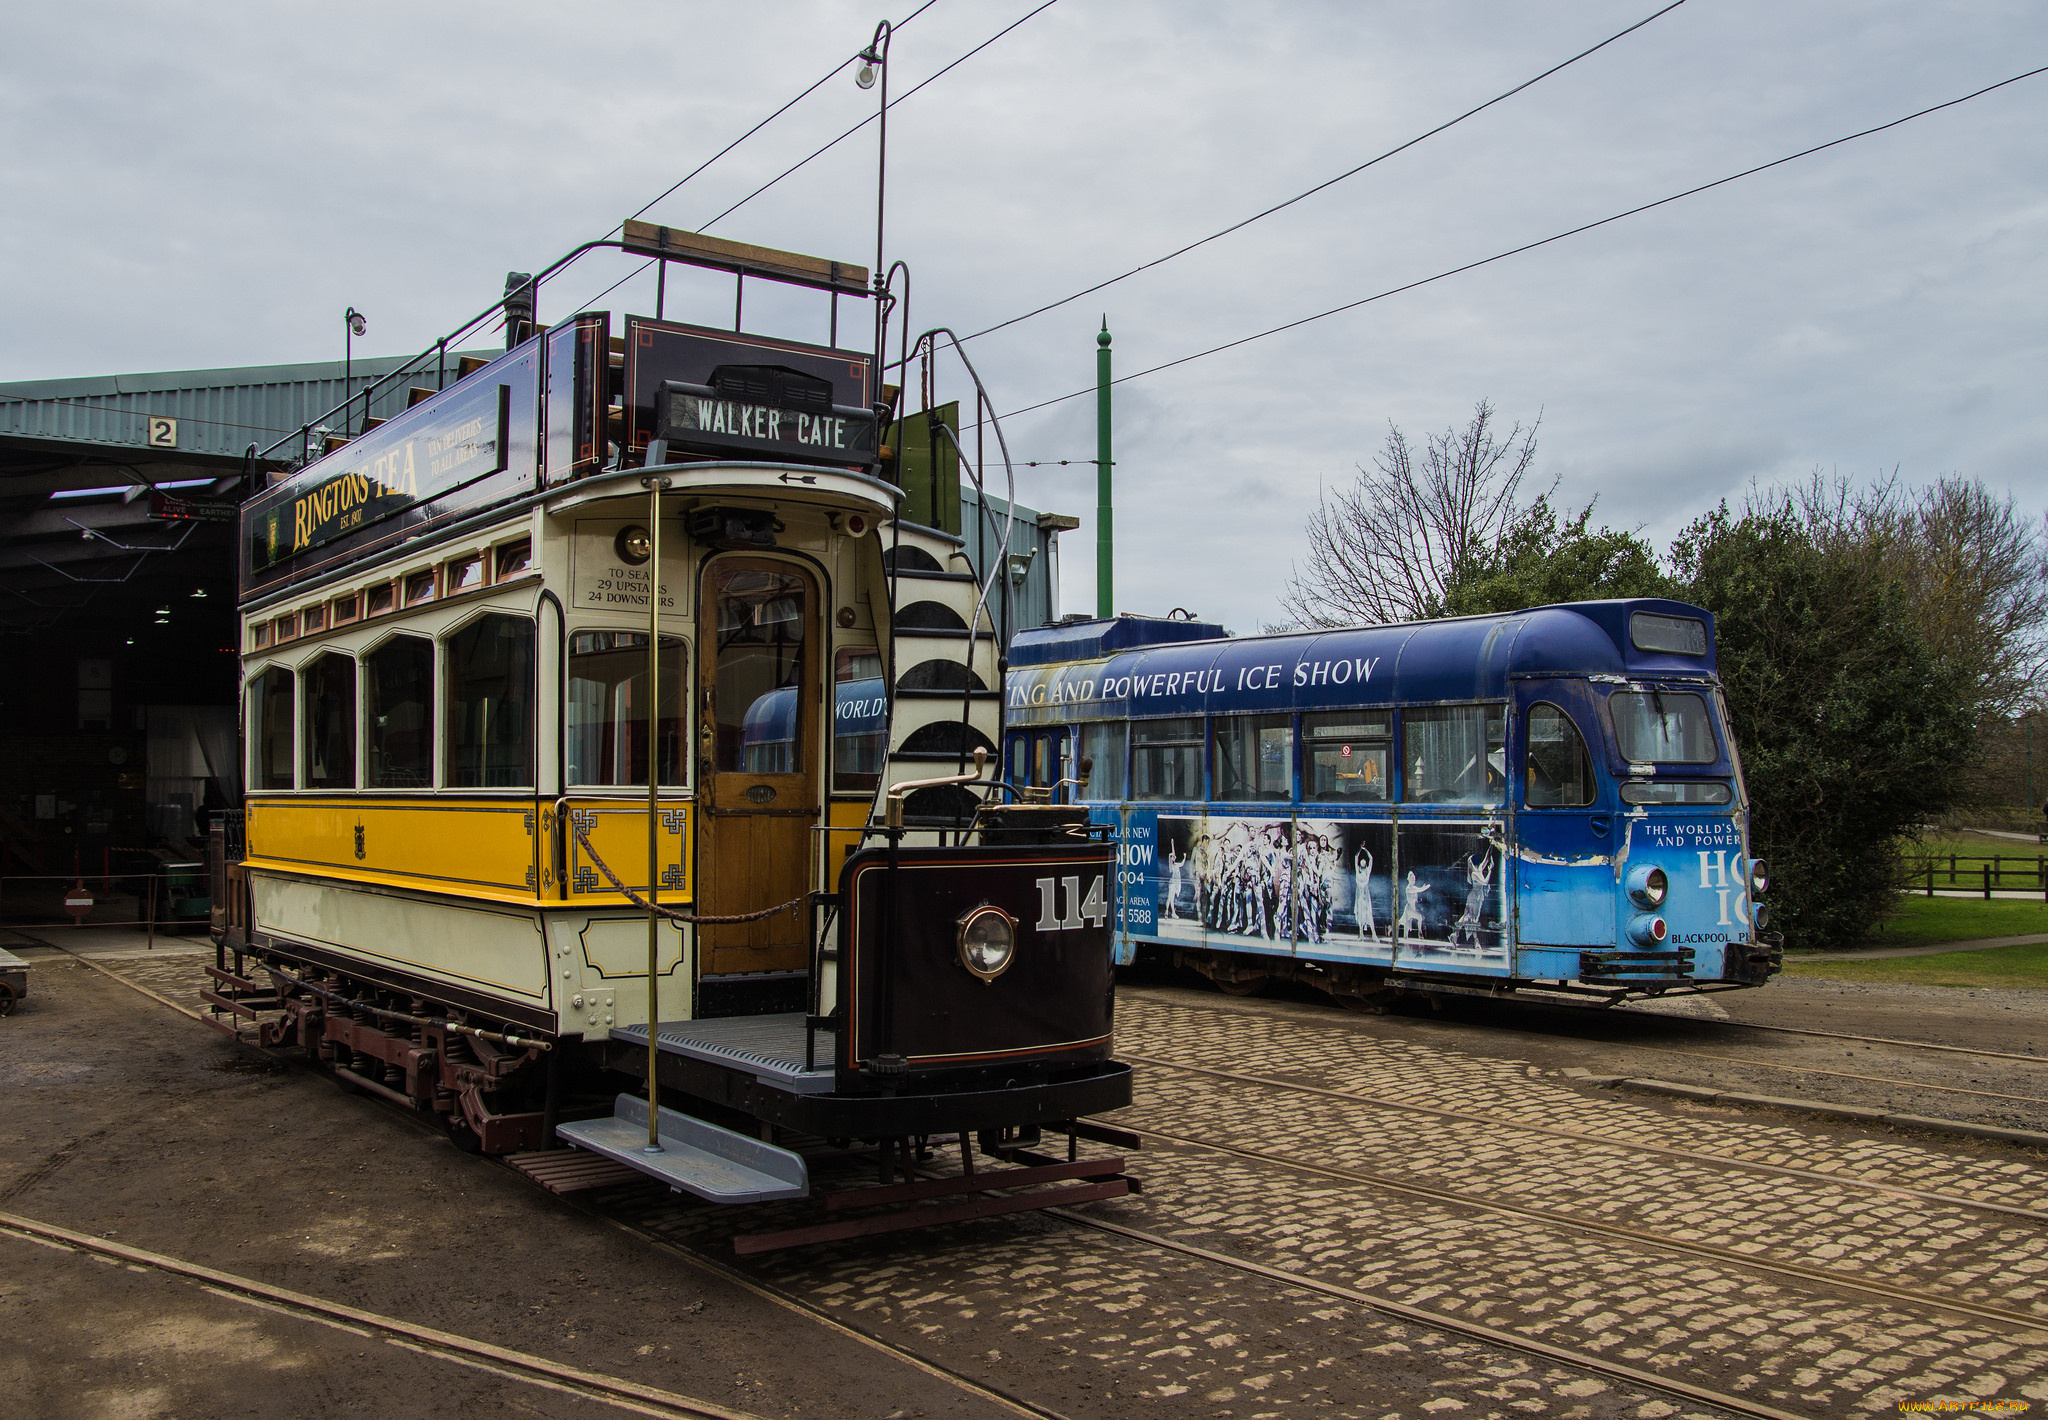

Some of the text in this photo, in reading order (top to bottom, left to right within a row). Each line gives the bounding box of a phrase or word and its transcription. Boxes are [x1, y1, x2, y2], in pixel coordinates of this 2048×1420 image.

[698, 400, 780, 440] WALKER
[155, 421, 171, 443] 2
[428, 417, 482, 458] VAN DELIVERIES
[431, 441, 478, 476] TO ALL AREAS
[293, 441, 418, 553] RINGTONS TEA
[162, 505, 187, 513] ALIVE
[609, 568, 650, 580] TO SEA
[597, 580, 667, 595] 29 UPSTAS
[588, 591, 674, 607] 24 DOWNSTRS
[1006, 657, 1380, 706] ING AND POWERFUL ICE SHOW
[1132, 827, 1151, 838] NEW
[1645, 823, 1732, 835] THE WORLD'S
[1656, 835, 1741, 847] AND POWER
[1117, 870, 1145, 885] 004
[1035, 875, 1108, 931] 114
[1129, 896, 1150, 907] ARENA
[1128, 908, 1152, 924] 5588
[1671, 933, 1731, 944] BLACKPOOL
